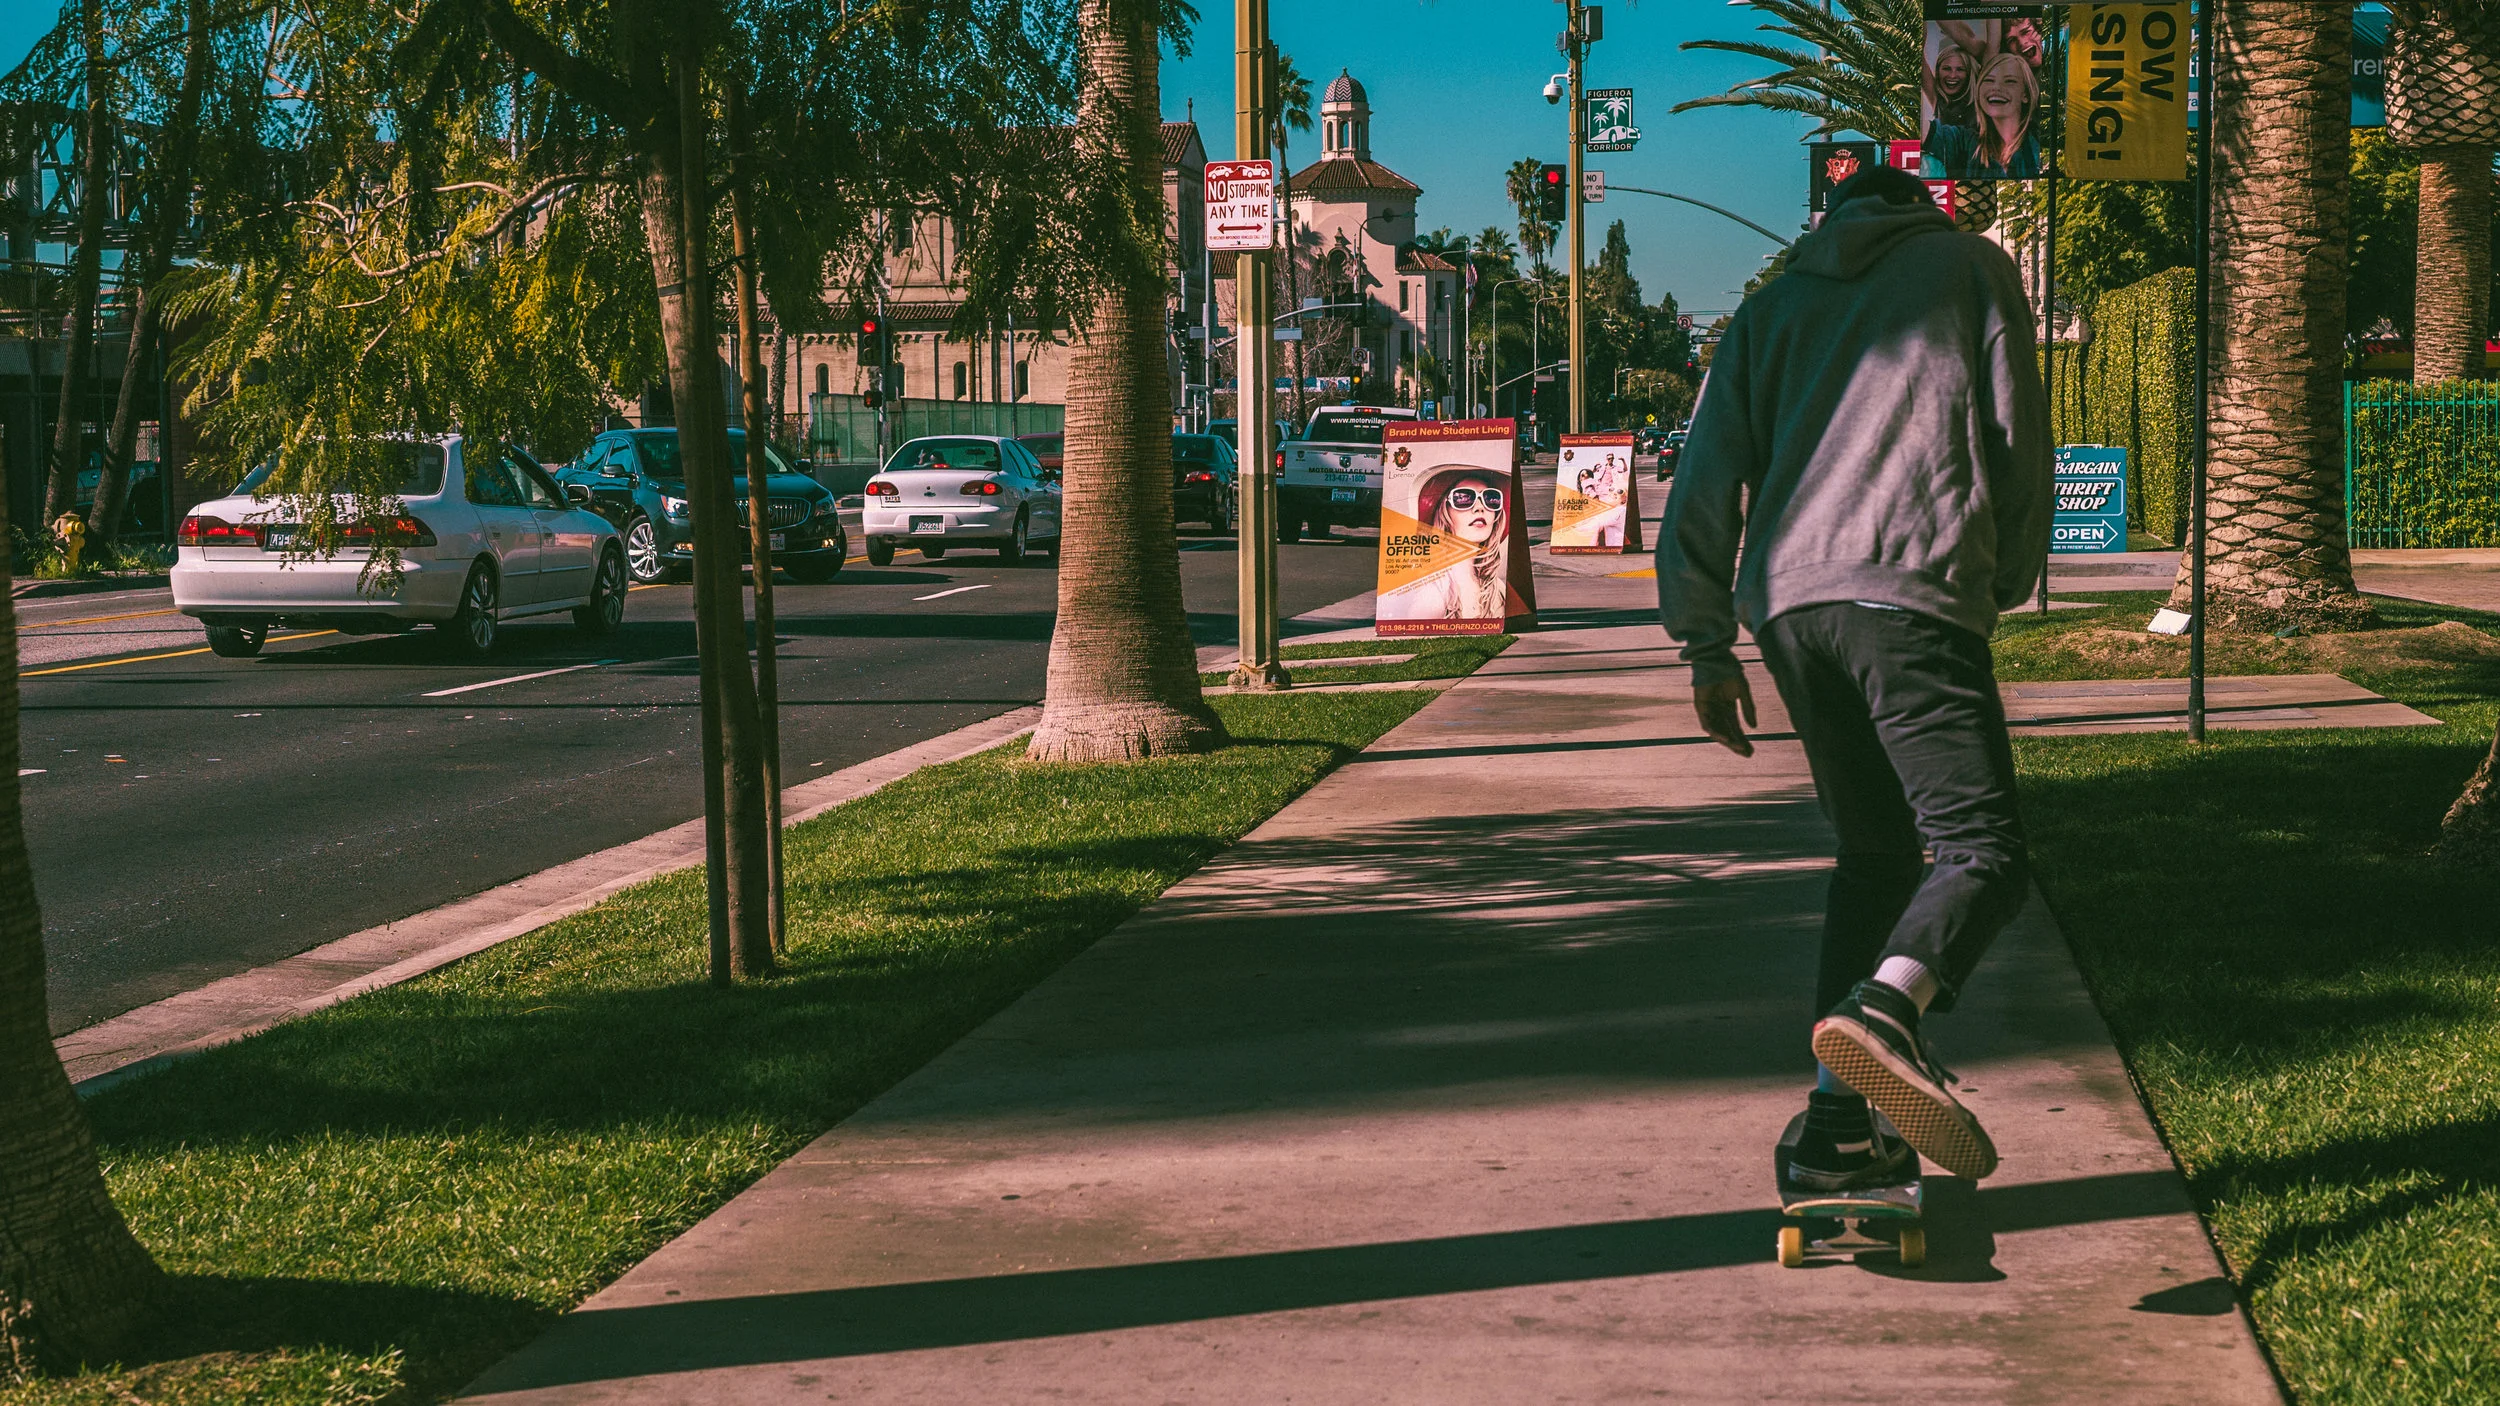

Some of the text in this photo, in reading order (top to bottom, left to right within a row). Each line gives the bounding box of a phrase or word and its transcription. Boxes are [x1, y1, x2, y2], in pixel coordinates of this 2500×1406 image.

[2140, 3, 2177, 102] OW
[2087, 4, 2127, 160] SING!
[1588, 90, 1631, 98] FIGUEROA
[1588, 143, 1632, 151] CORRIDOR
[1586, 174, 1597, 182] NO
[1208, 180, 1270, 201] NO STOPPING
[1210, 204, 1268, 219] ANY TIME
[1389, 425, 1510, 437] Brand New Student Living
[2063, 451, 2071, 459] a
[2054, 462, 2121, 474] BARGAIN
[2054, 482, 2115, 495] THRIFT
[2056, 497, 2106, 510] SHOP
[2054, 528, 2104, 540] OPEN
[1387, 535, 1440, 546] LEASING
[1386, 546, 1431, 556] OFFICE
[1380, 623, 1500, 632] 213.984.2218 THELORENZO.COM
